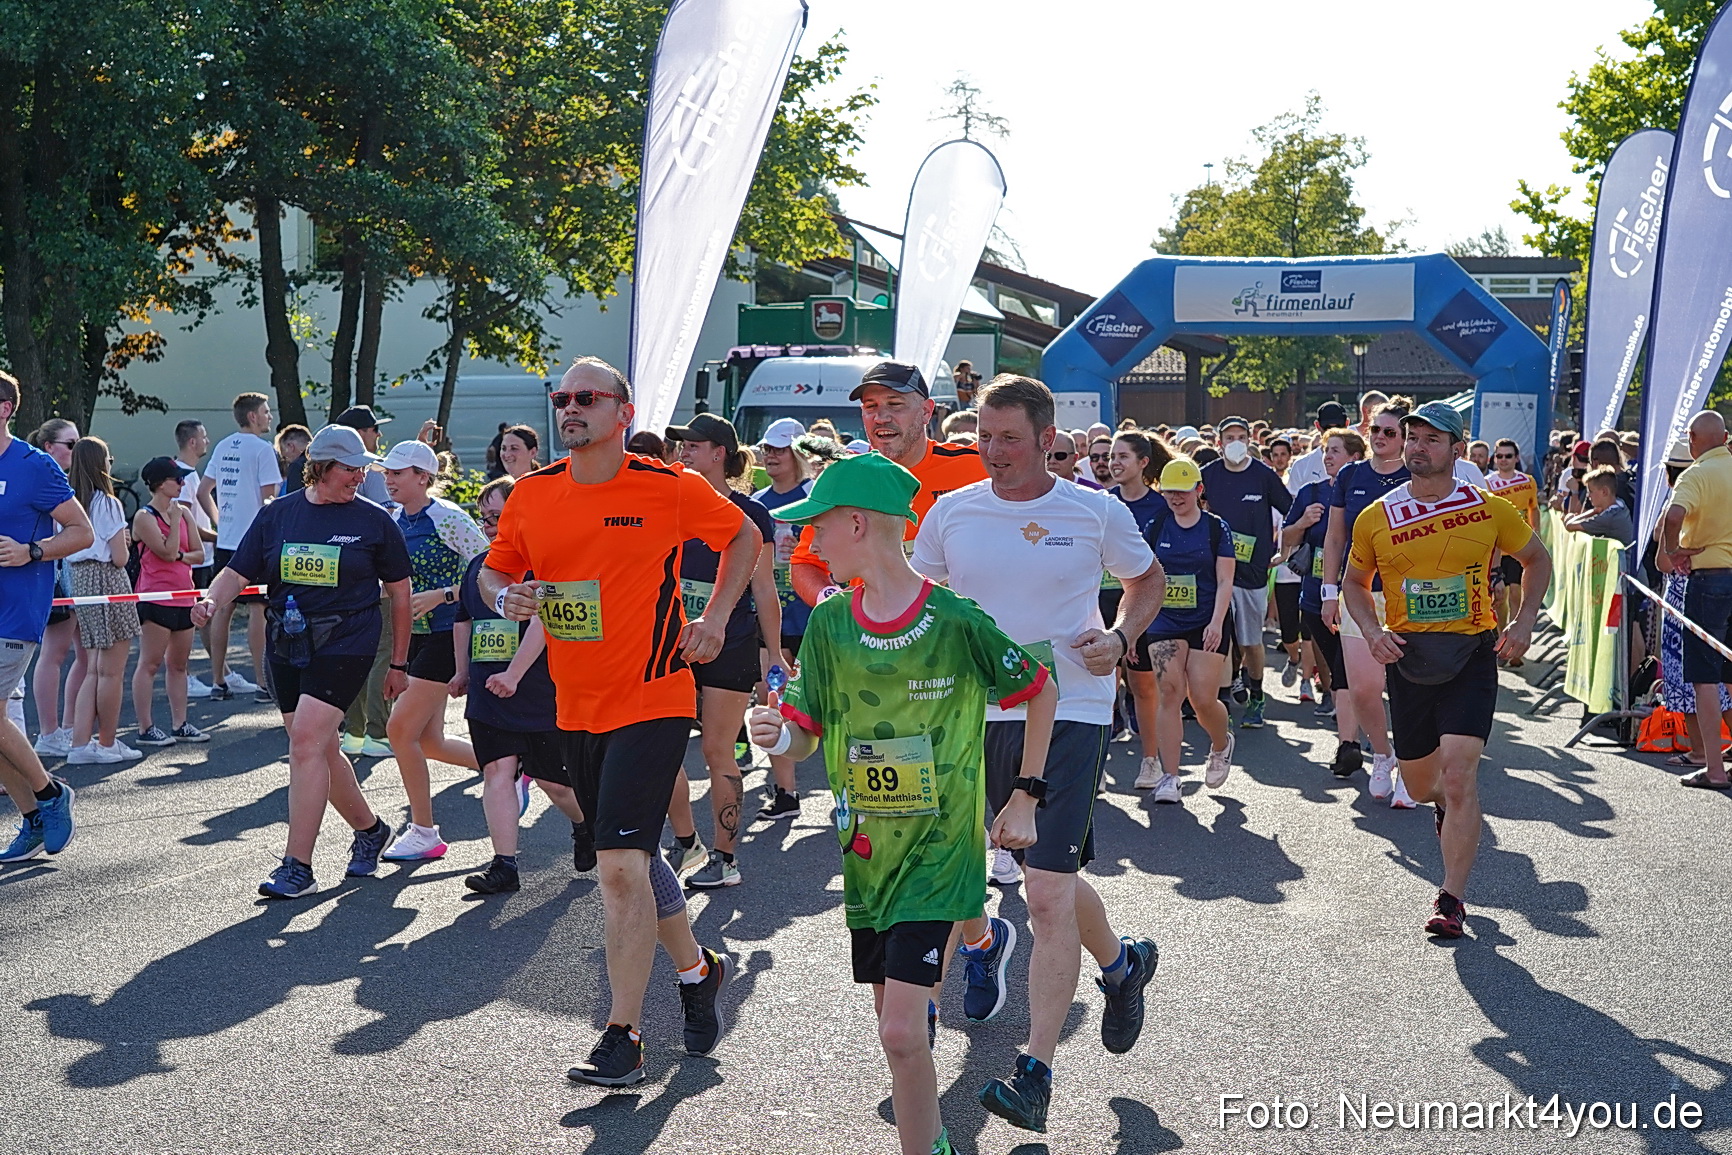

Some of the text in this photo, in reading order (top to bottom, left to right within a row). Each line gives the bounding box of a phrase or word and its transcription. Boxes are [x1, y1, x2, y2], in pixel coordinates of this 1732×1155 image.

[692, 15, 755, 147] Fische
[1622, 155, 1668, 259] Fischer
[1266, 293, 1355, 310] firmenlauf
[1095, 320, 1143, 333] Fischer
[604, 517, 643, 527] THULE
[1391, 509, 1492, 546] MAX BÖGL
[295, 557, 324, 572] 869
[1167, 586, 1188, 597] 279
[1416, 592, 1458, 609] 1623
[543, 602, 588, 622] 1463
[590, 604, 598, 632] 2022
[860, 612, 935, 650] MONSTERSTARK
[5, 642, 24, 650] PUMA
[480, 634, 505, 648] 866
[848, 767, 856, 803] WALK
[866, 767, 899, 791] 89
[920, 767, 933, 803] 2022
[856, 792, 922, 803] Pfindel Matthias
